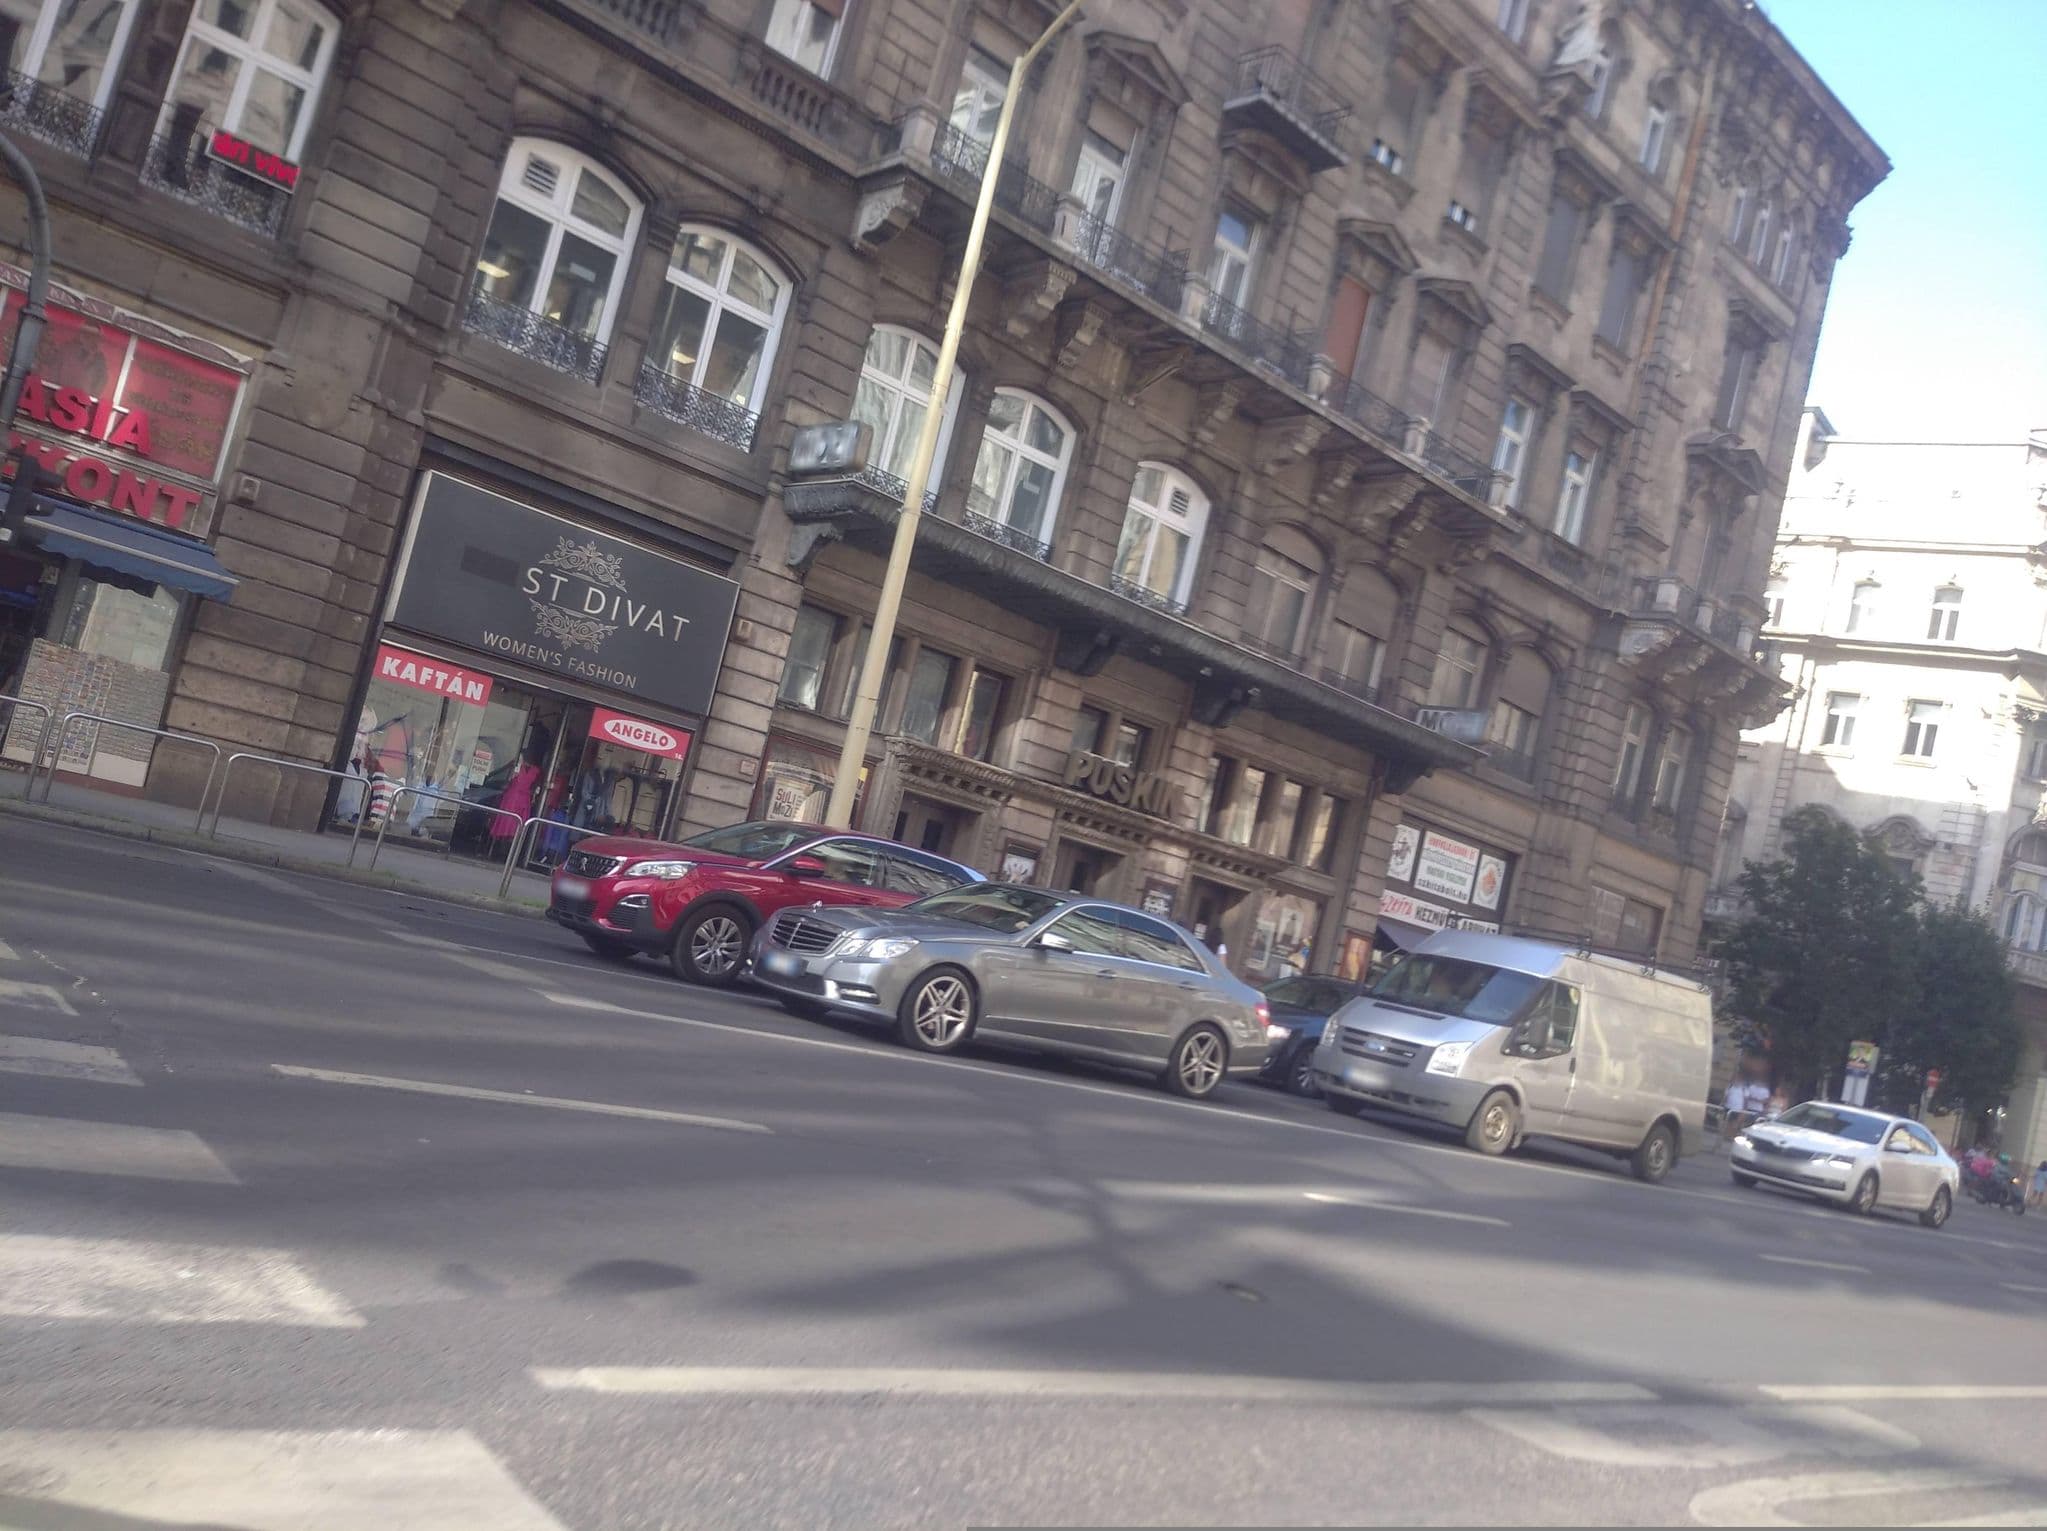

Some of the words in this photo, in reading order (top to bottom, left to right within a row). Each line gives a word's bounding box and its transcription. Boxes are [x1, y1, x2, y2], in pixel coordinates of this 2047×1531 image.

[522, 567, 569, 602] ST
[583, 586, 690, 642] DIVAT
[381, 655, 485, 701] KAFTÁN
[483, 630, 563, 667] WOMEN'S
[567, 656, 637, 690] FASHION
[611, 722, 669, 748] ANGELO
[1063, 750, 1184, 820] PUSKIN
